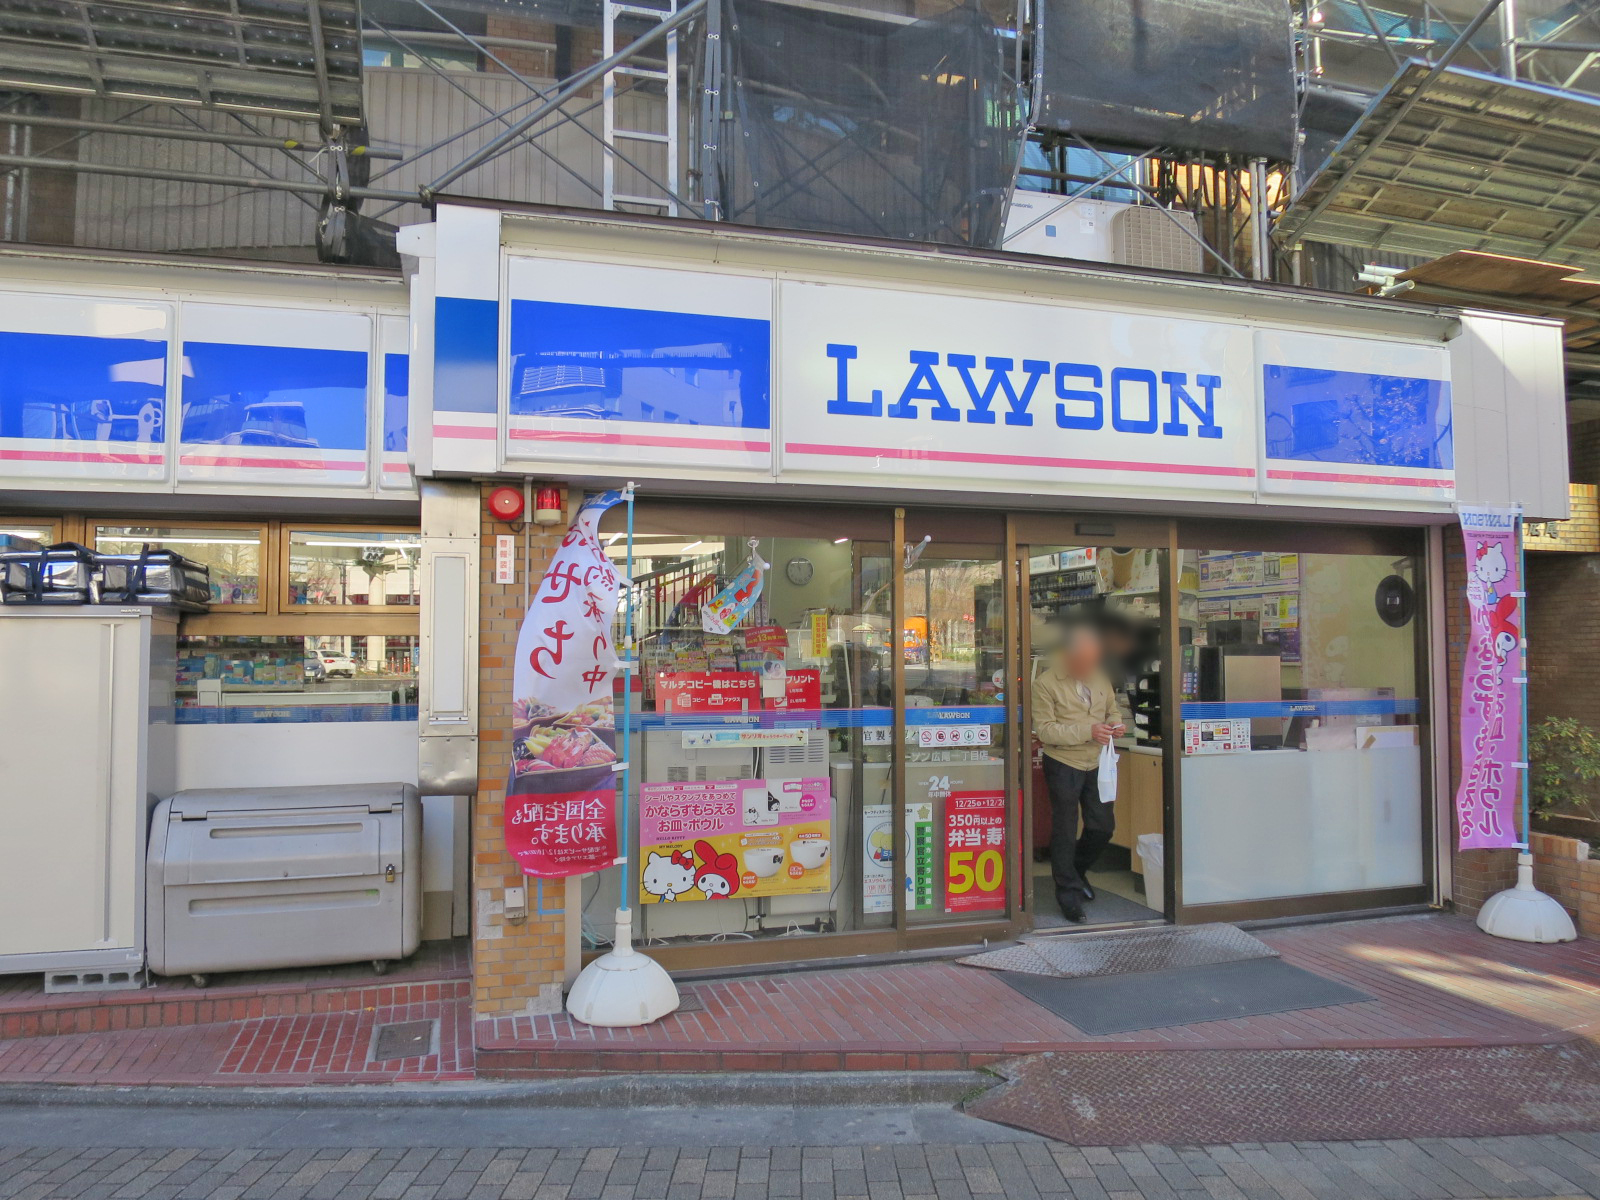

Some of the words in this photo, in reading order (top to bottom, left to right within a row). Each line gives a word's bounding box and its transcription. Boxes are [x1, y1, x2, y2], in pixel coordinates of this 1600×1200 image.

[827, 344, 1222, 438] LAWSON
[659, 678, 756, 689] マルチコピー機はこちら
[905, 750, 989, 762] ーソン広尾一丁目店
[928, 775, 950, 791] 24
[645, 792, 736, 803] シールやスタンプをあつめて
[645, 803, 736, 818] かならずもらえる
[948, 814, 1002, 827] 350円以上の
[948, 828, 1005, 848] 弁当・寿
[948, 849, 1004, 894] 50
